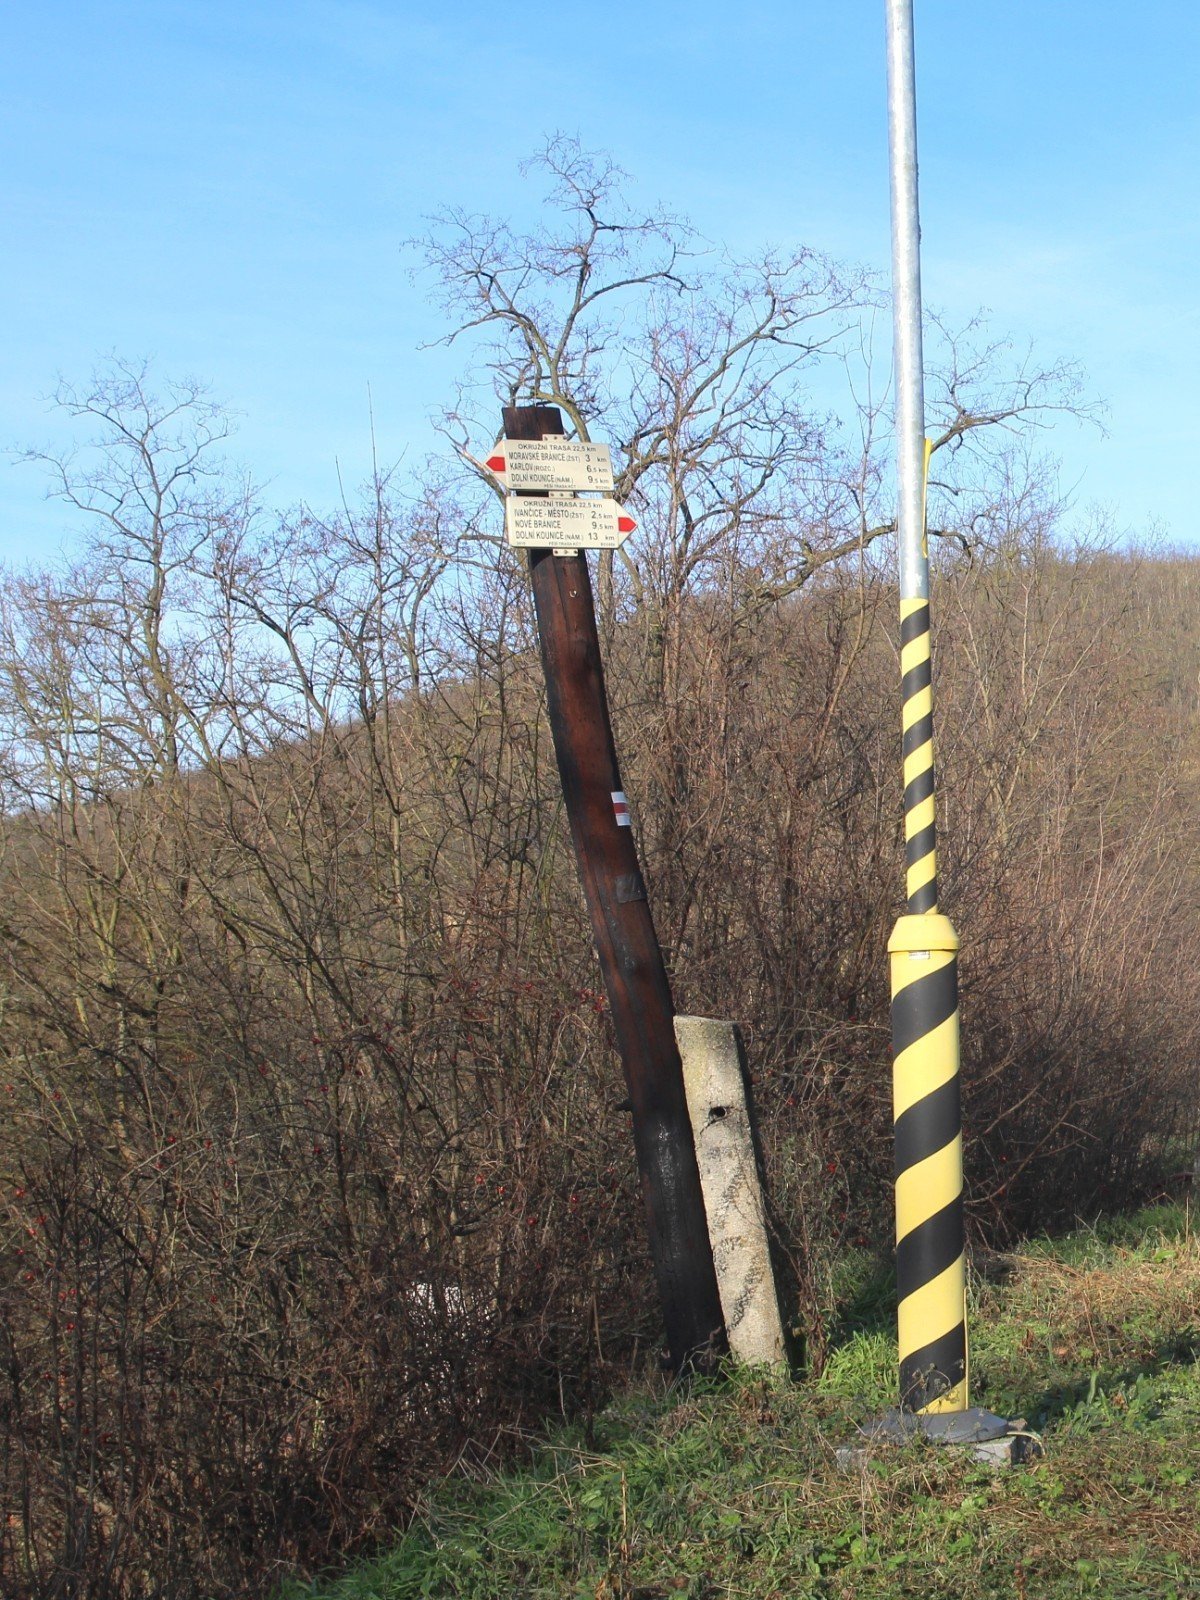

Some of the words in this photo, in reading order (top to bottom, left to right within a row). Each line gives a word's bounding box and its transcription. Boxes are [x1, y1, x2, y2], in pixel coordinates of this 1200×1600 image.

[509, 451, 540, 460] MORAVSKÉ
[541, 453, 565, 461] BRANICE
[585, 454, 591, 462] 3
[510, 463, 533, 471] KARLOV
[511, 472, 529, 482] DOLNÍ
[529, 474, 555, 482] KOUNICE
[514, 508, 542, 518] IVANČICE
[547, 508, 569, 518] MĚSTO
[534, 520, 561, 529] BRANICE
[515, 530, 535, 539] DOLNÍ
[536, 531, 564, 540] KOUNICE
[588, 532, 598, 541] 13
